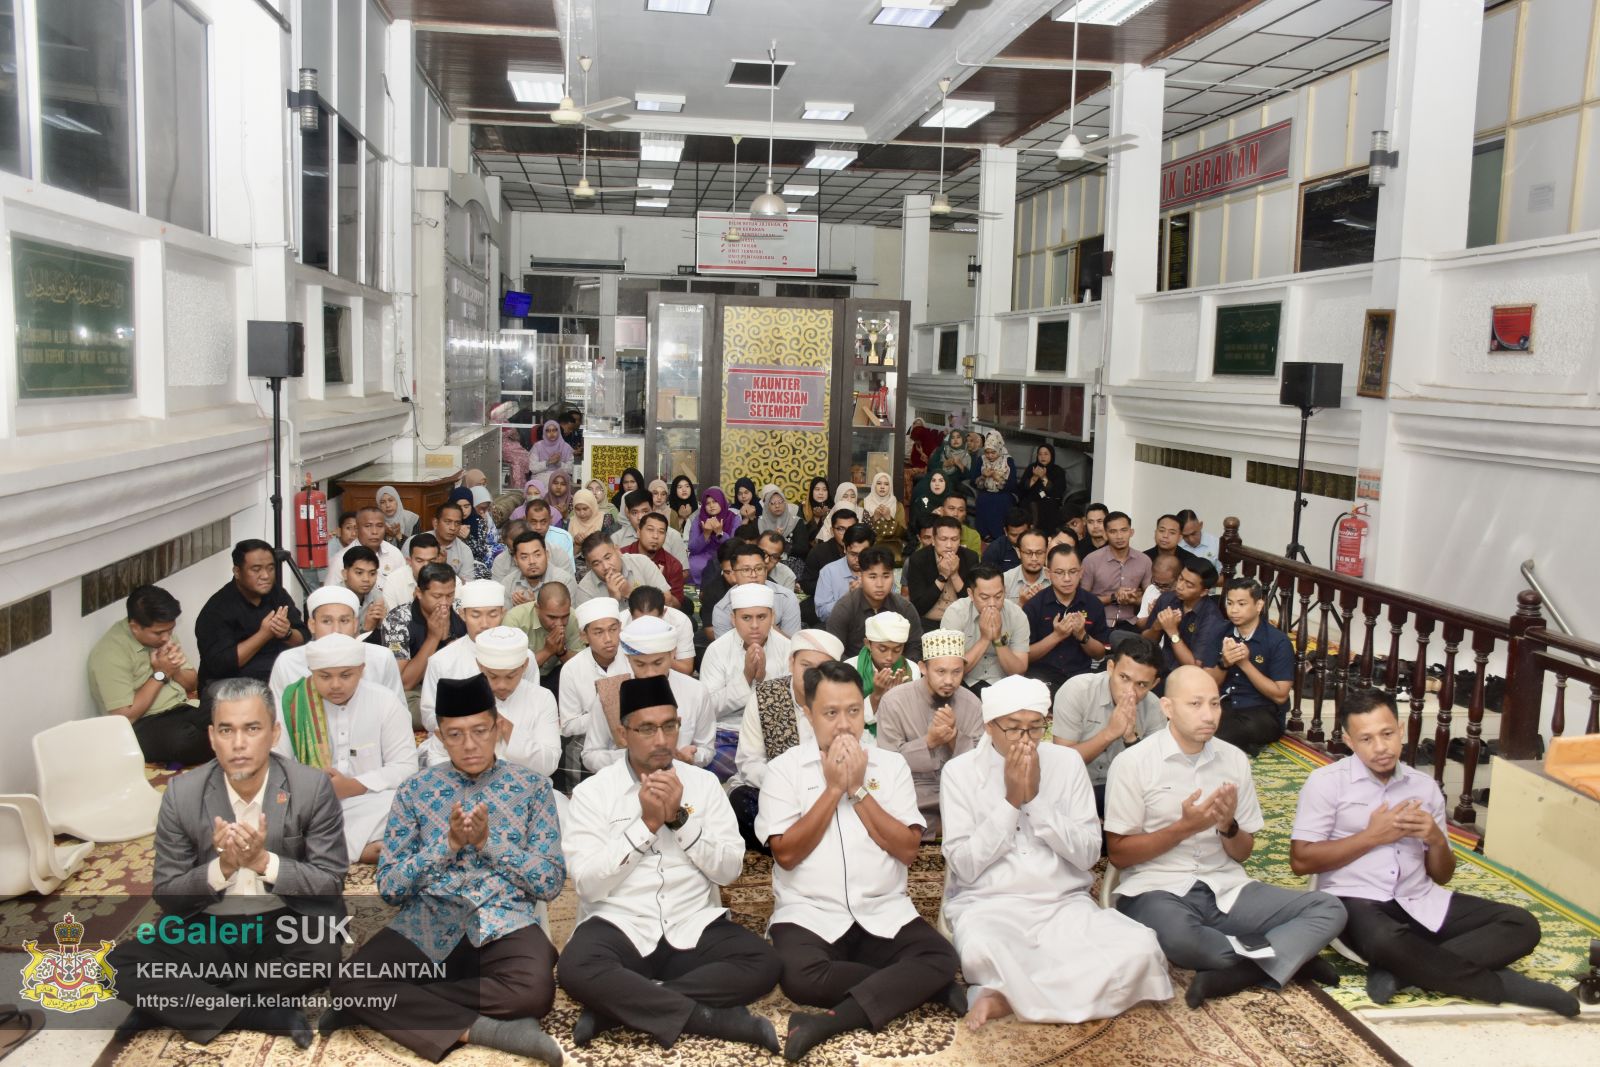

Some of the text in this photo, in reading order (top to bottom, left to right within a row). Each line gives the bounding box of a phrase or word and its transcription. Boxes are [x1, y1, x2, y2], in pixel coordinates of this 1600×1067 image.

[1183, 141, 1260, 195] GERAKAN
[753, 376, 801, 390] KAUNTER
[744, 390, 808, 405] PENYAKSIAN
[749, 404, 802, 418] SETEMPAT
